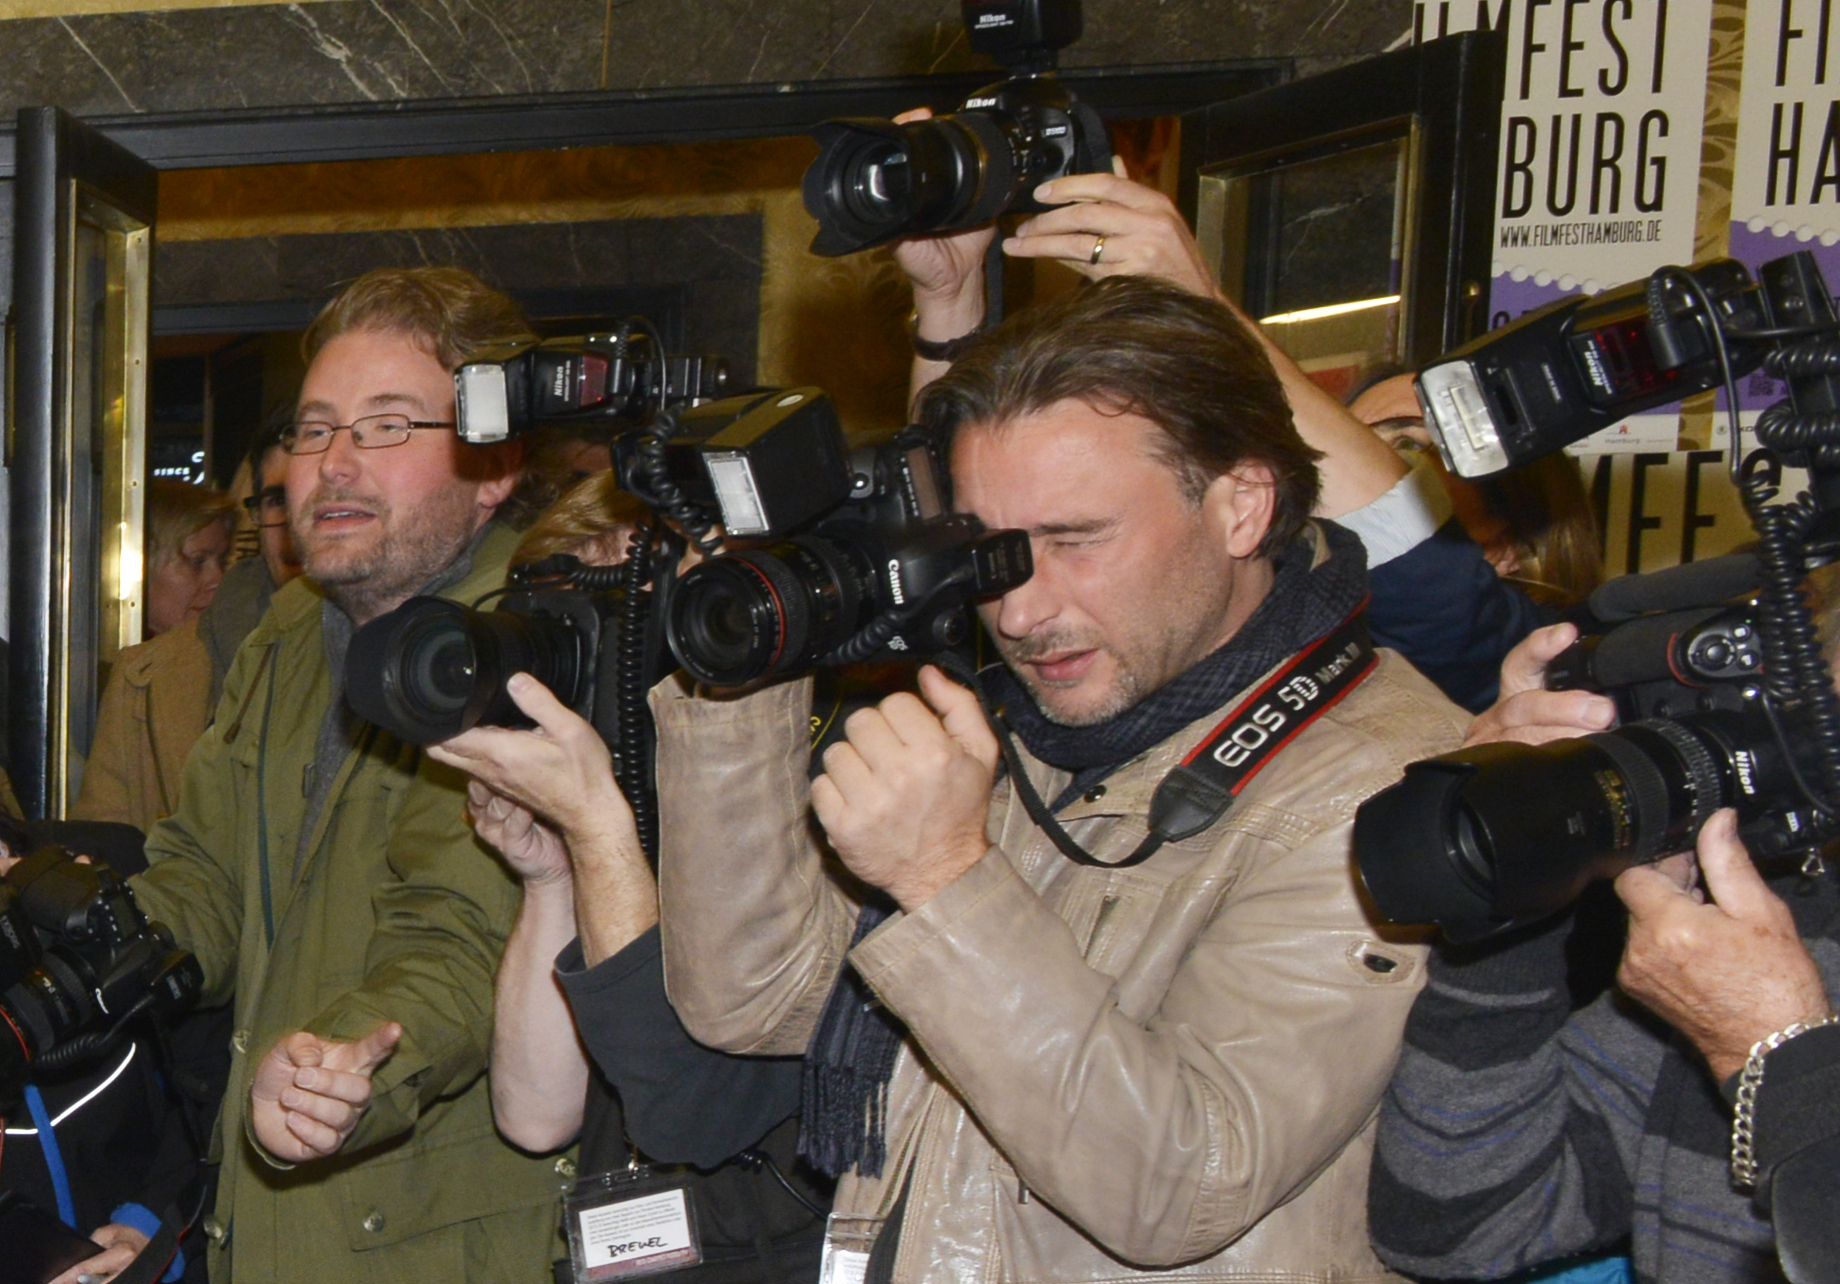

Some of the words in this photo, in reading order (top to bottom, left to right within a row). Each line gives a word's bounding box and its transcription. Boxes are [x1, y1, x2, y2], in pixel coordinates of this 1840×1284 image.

[965, 98, 997, 109] Nikon
[1501, 108, 1670, 219] BURG
[1500, 219, 1661, 249] WWW.FILMFESTHAMBURG.DE
[887, 558, 904, 605] Canon
[1213, 703, 1287, 768] EOS
[1277, 675, 1320, 711] 5D
[1314, 653, 1354, 685] Mark
[1735, 750, 1756, 795] Nikon
